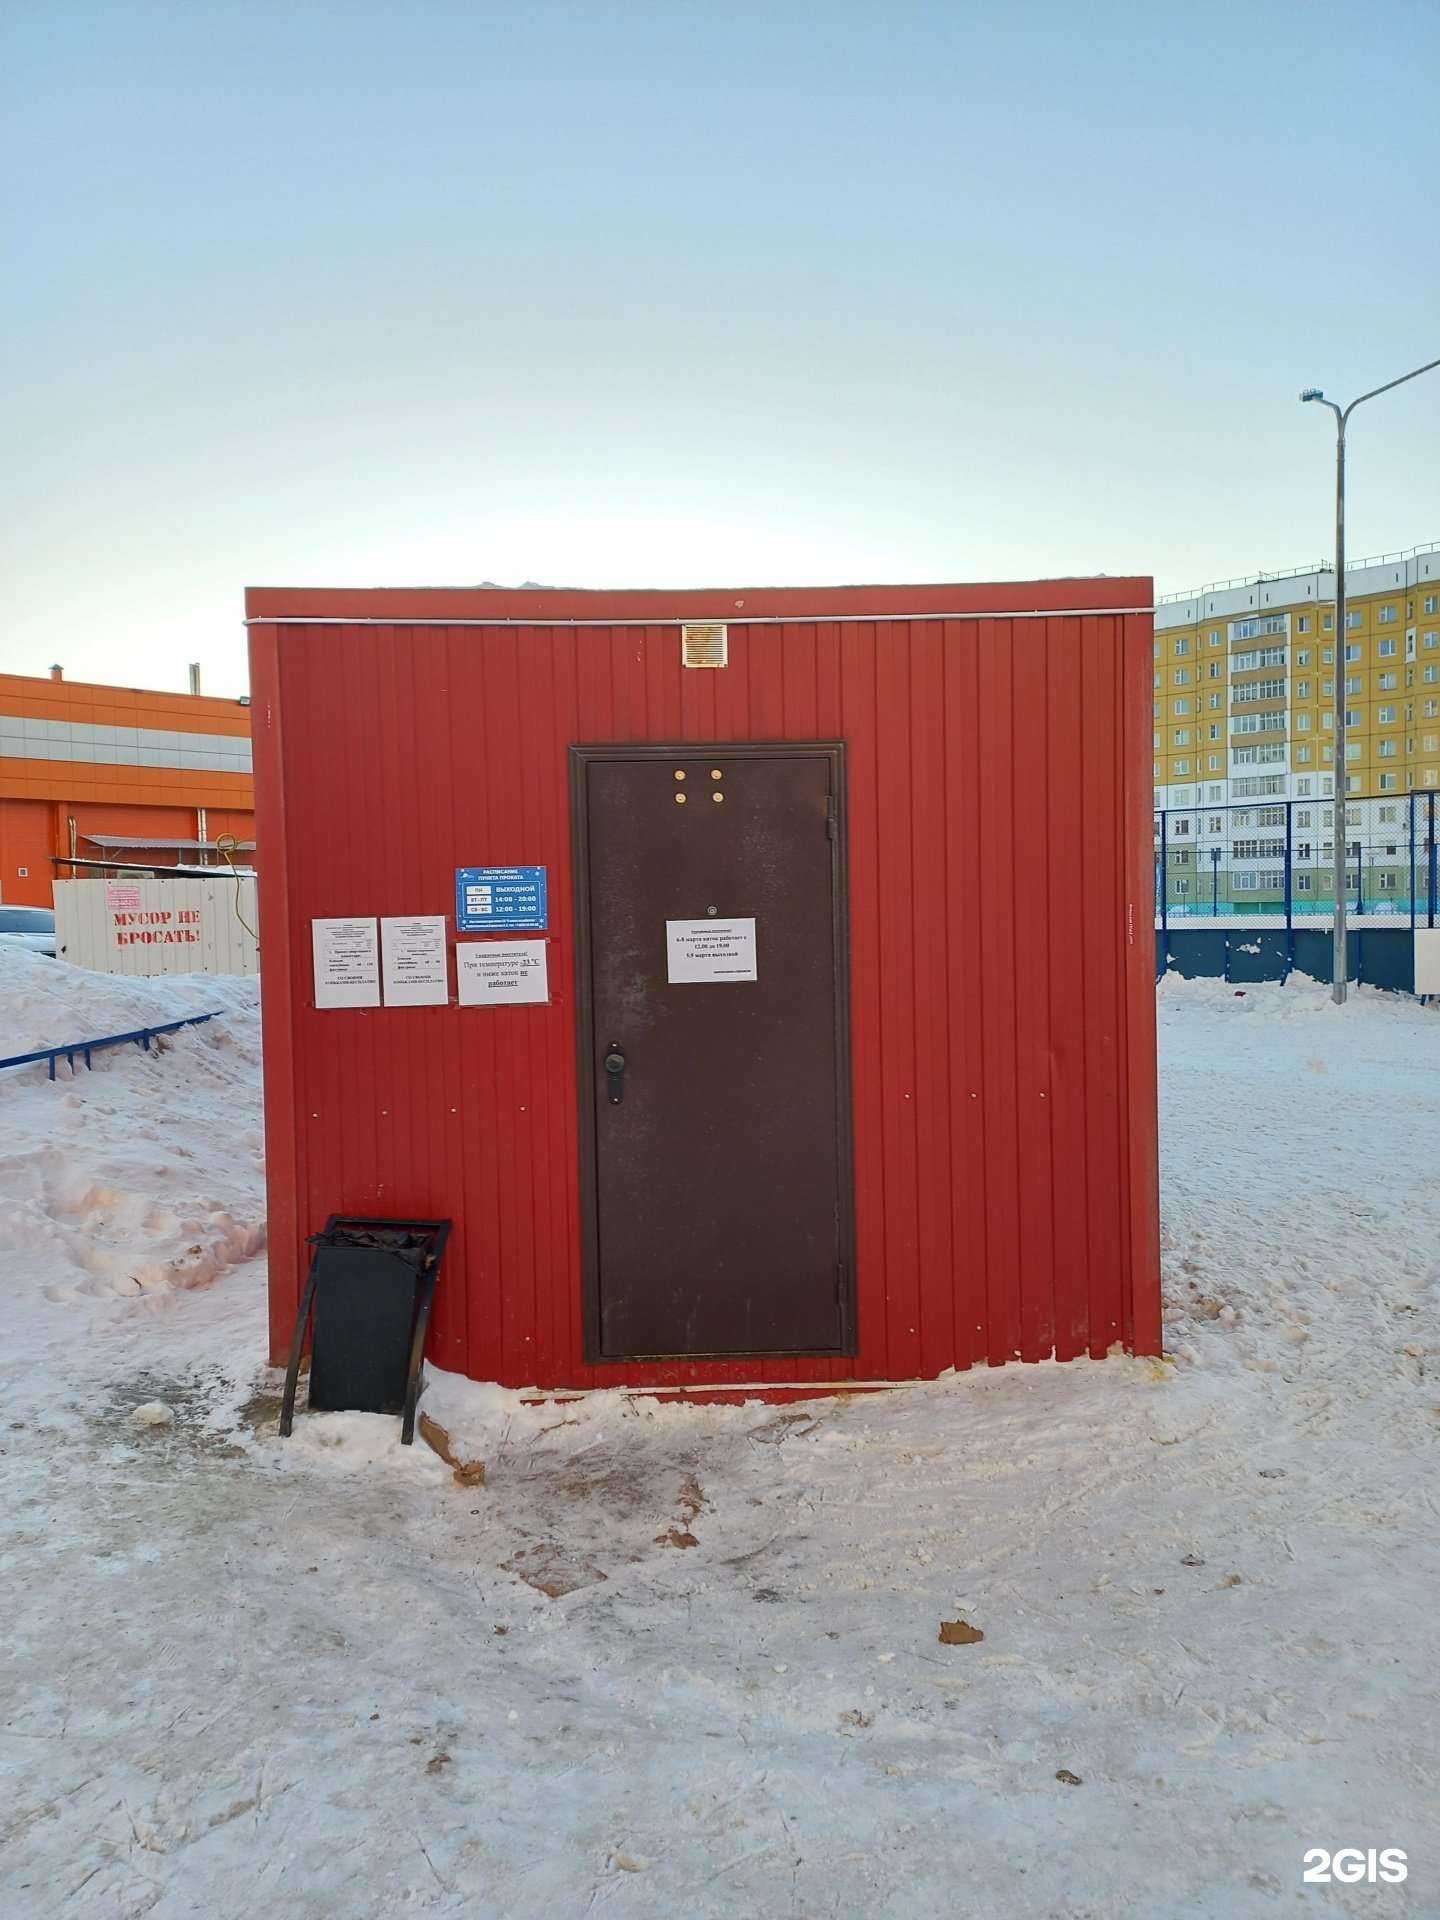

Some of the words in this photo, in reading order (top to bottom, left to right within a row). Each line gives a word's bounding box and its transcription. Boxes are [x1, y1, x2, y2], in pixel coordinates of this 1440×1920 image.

[495, 885, 535, 893] ВЫХОДНОЙ
[114, 911, 172, 926] МУСОР
[177, 910, 200, 923] НЕ
[116, 929, 200, 945] БРОСАТЬ!
[479, 961, 518, 969] температуре
[488, 980, 518, 988] работает
